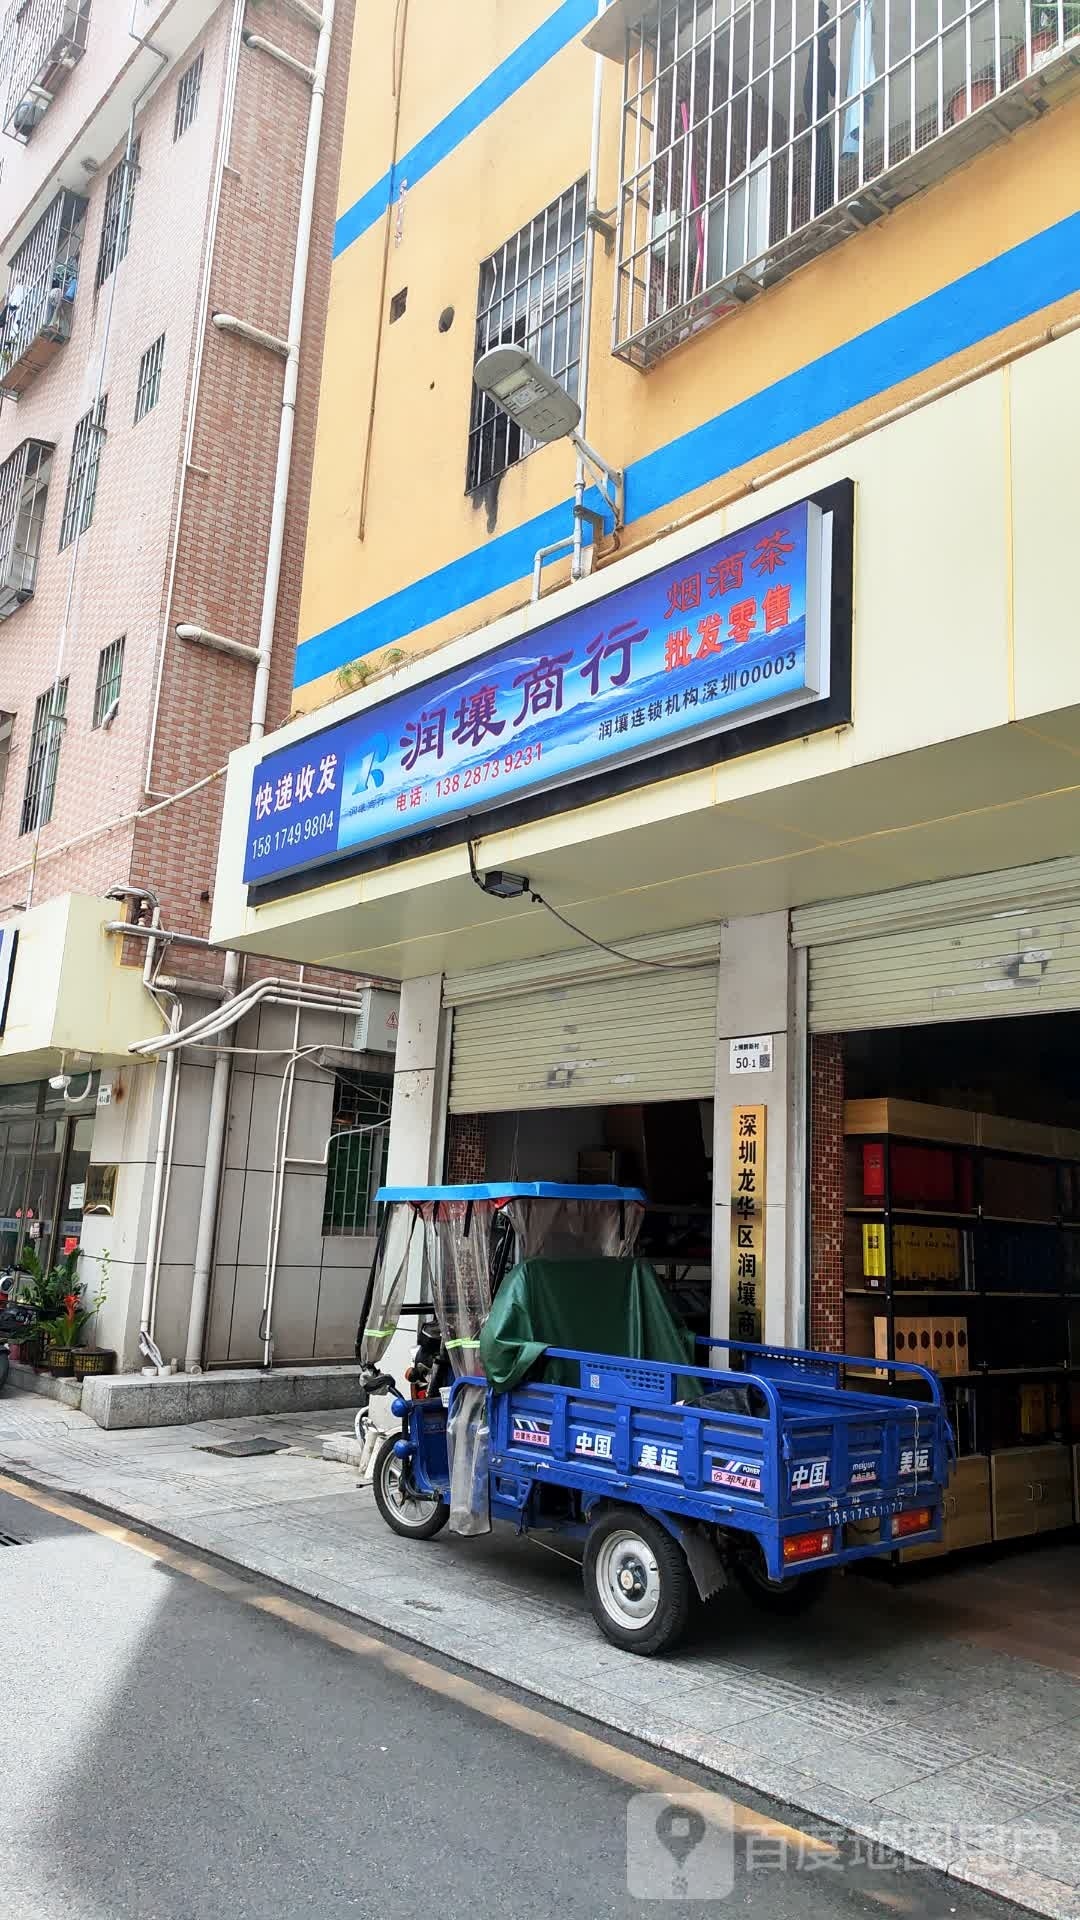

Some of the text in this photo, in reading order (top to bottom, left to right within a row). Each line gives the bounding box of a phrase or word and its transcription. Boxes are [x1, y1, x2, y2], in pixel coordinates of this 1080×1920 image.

[664, 528, 795, 620] 烟酒茶
[664, 584, 793, 673] 批发零售
[399, 618, 649, 771] 润壤商行
[254, 753, 338, 821] 快递收发
[436, 774, 460, 797] 138
[463, 759, 500, 788] 2873
[503, 743, 543, 773] 9231
[252, 810, 334, 859] 158 1749 9804
[736, 1056, 756, 1069] 50-1
[575, 1432, 679, 1471] 中国 美运
[742, 1465, 761, 1475] POWER
[792, 1461, 827, 1488] 中国
[900, 1449, 929, 1473] 美运
